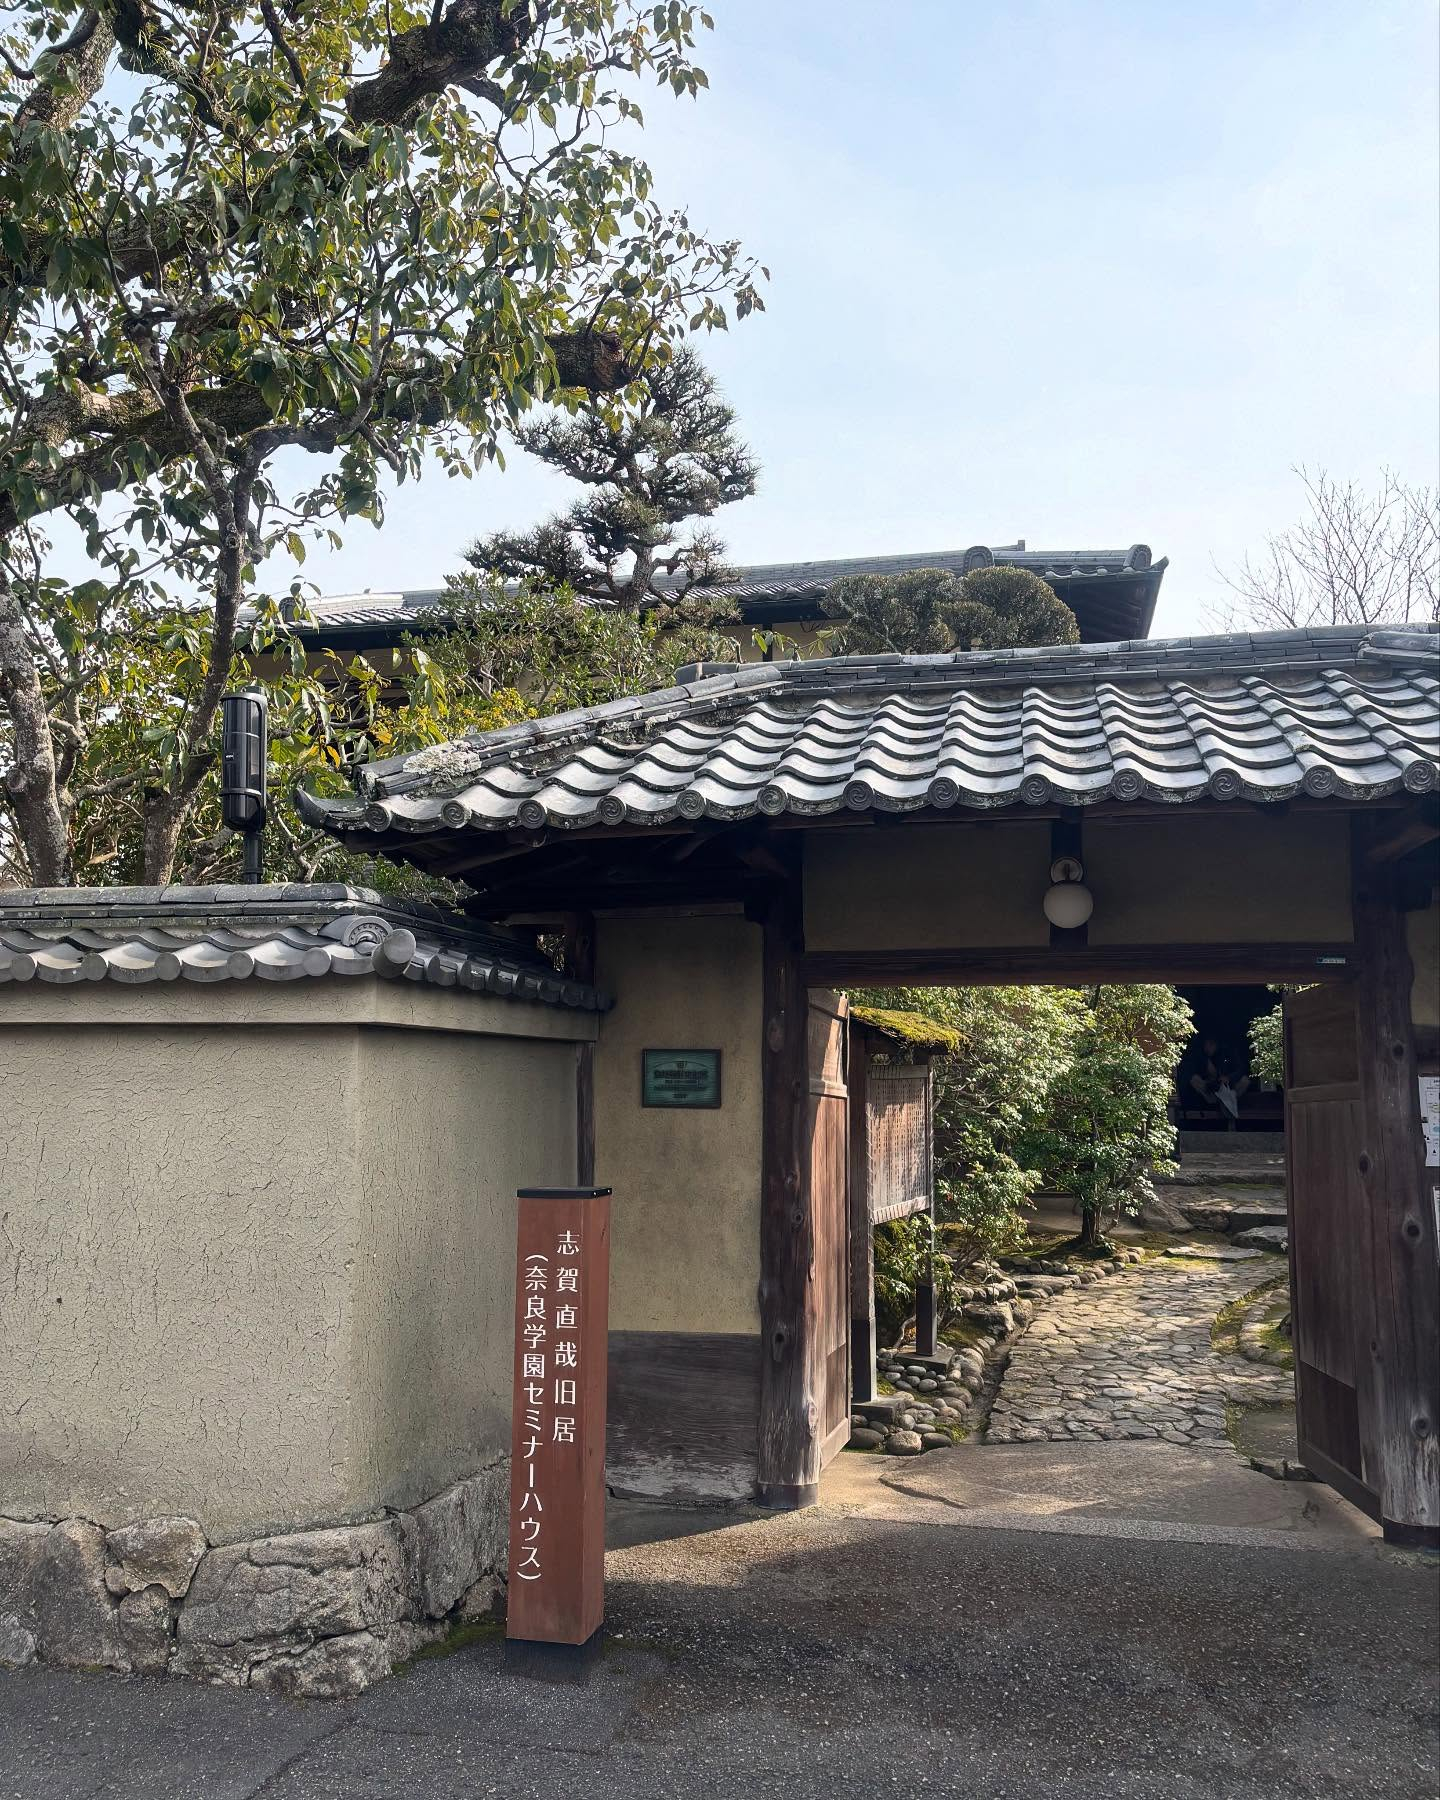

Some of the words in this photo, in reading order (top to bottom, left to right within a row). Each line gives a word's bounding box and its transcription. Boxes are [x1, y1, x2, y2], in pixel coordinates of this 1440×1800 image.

[516, 1254, 549, 1580] （奈良学園セミナーハウス）
[552, 1230, 580, 1443] 志賀直哉旧居
